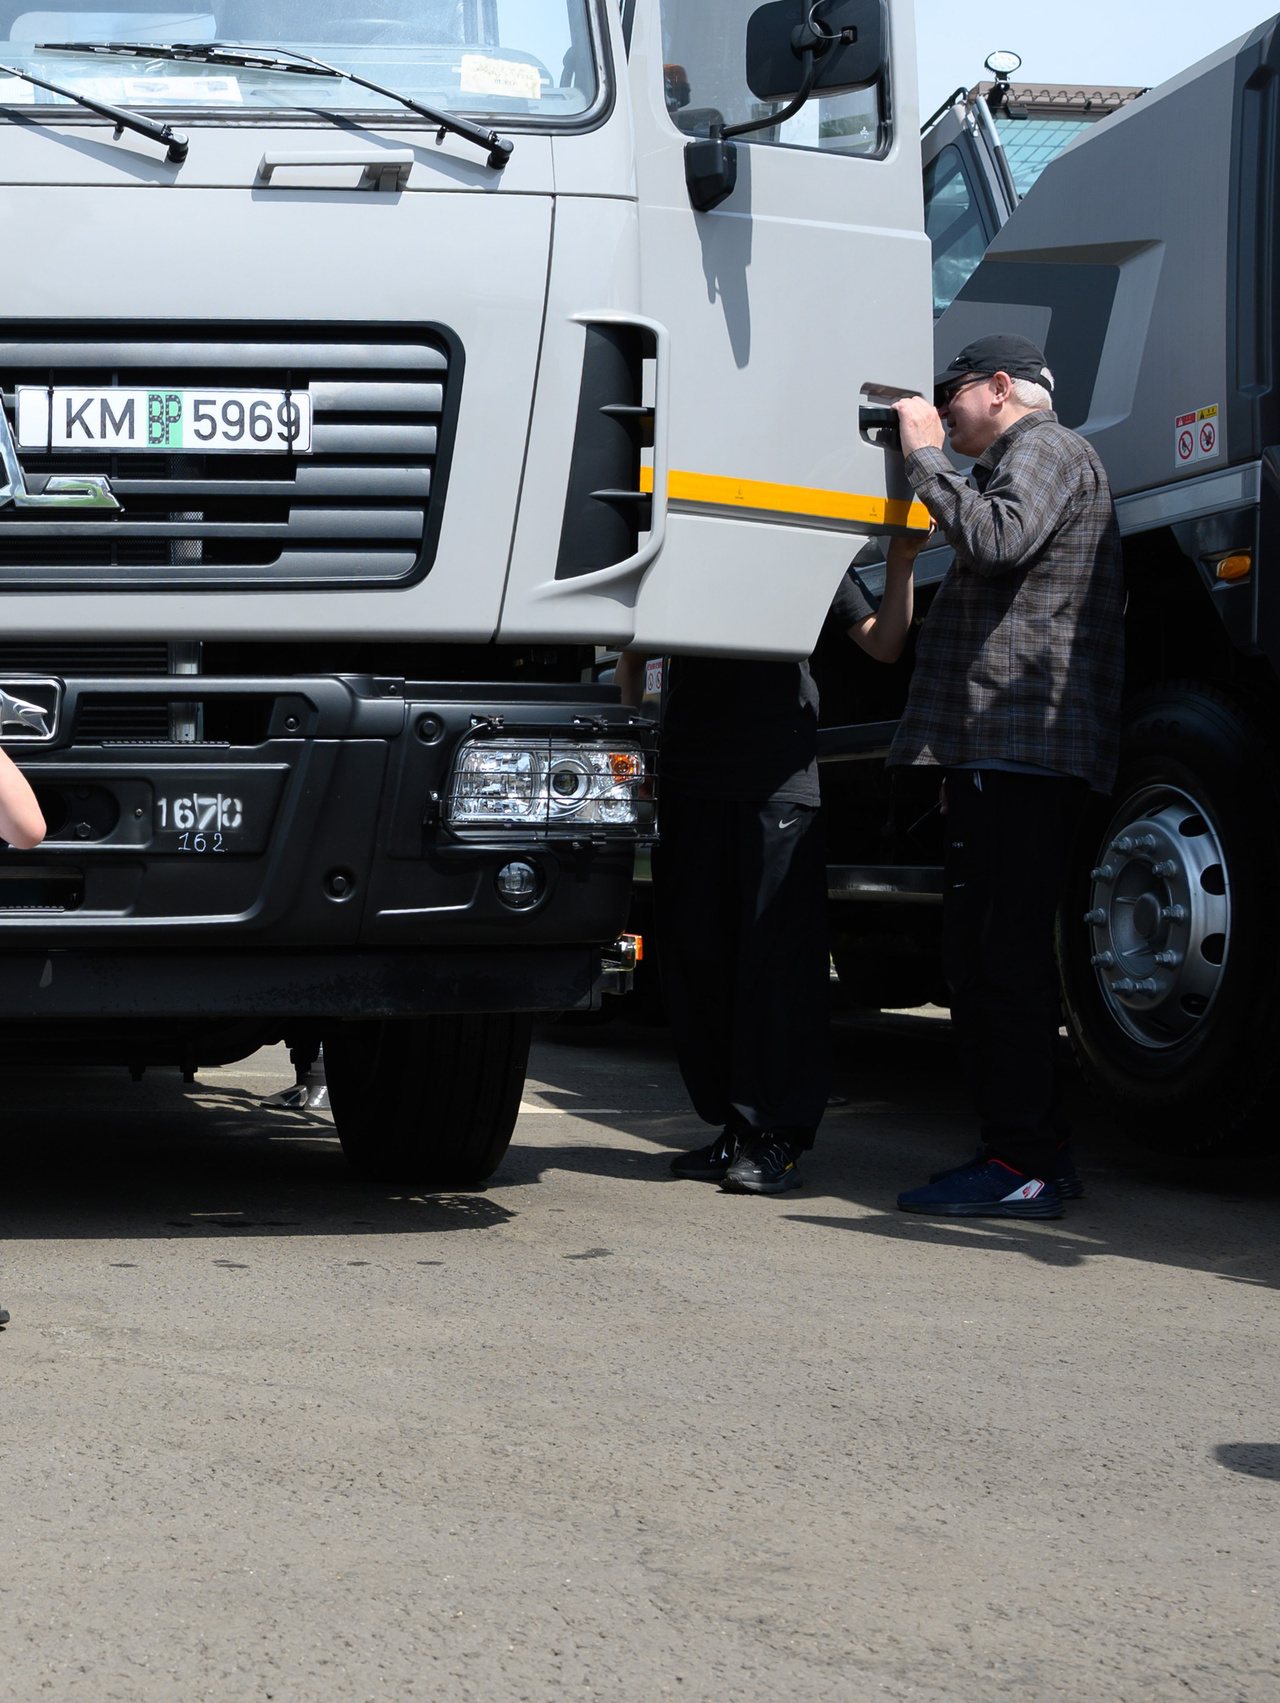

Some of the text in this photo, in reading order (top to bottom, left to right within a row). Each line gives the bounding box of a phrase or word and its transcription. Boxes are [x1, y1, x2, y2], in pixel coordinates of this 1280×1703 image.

[65, 394, 302, 444] KM BP 5969
